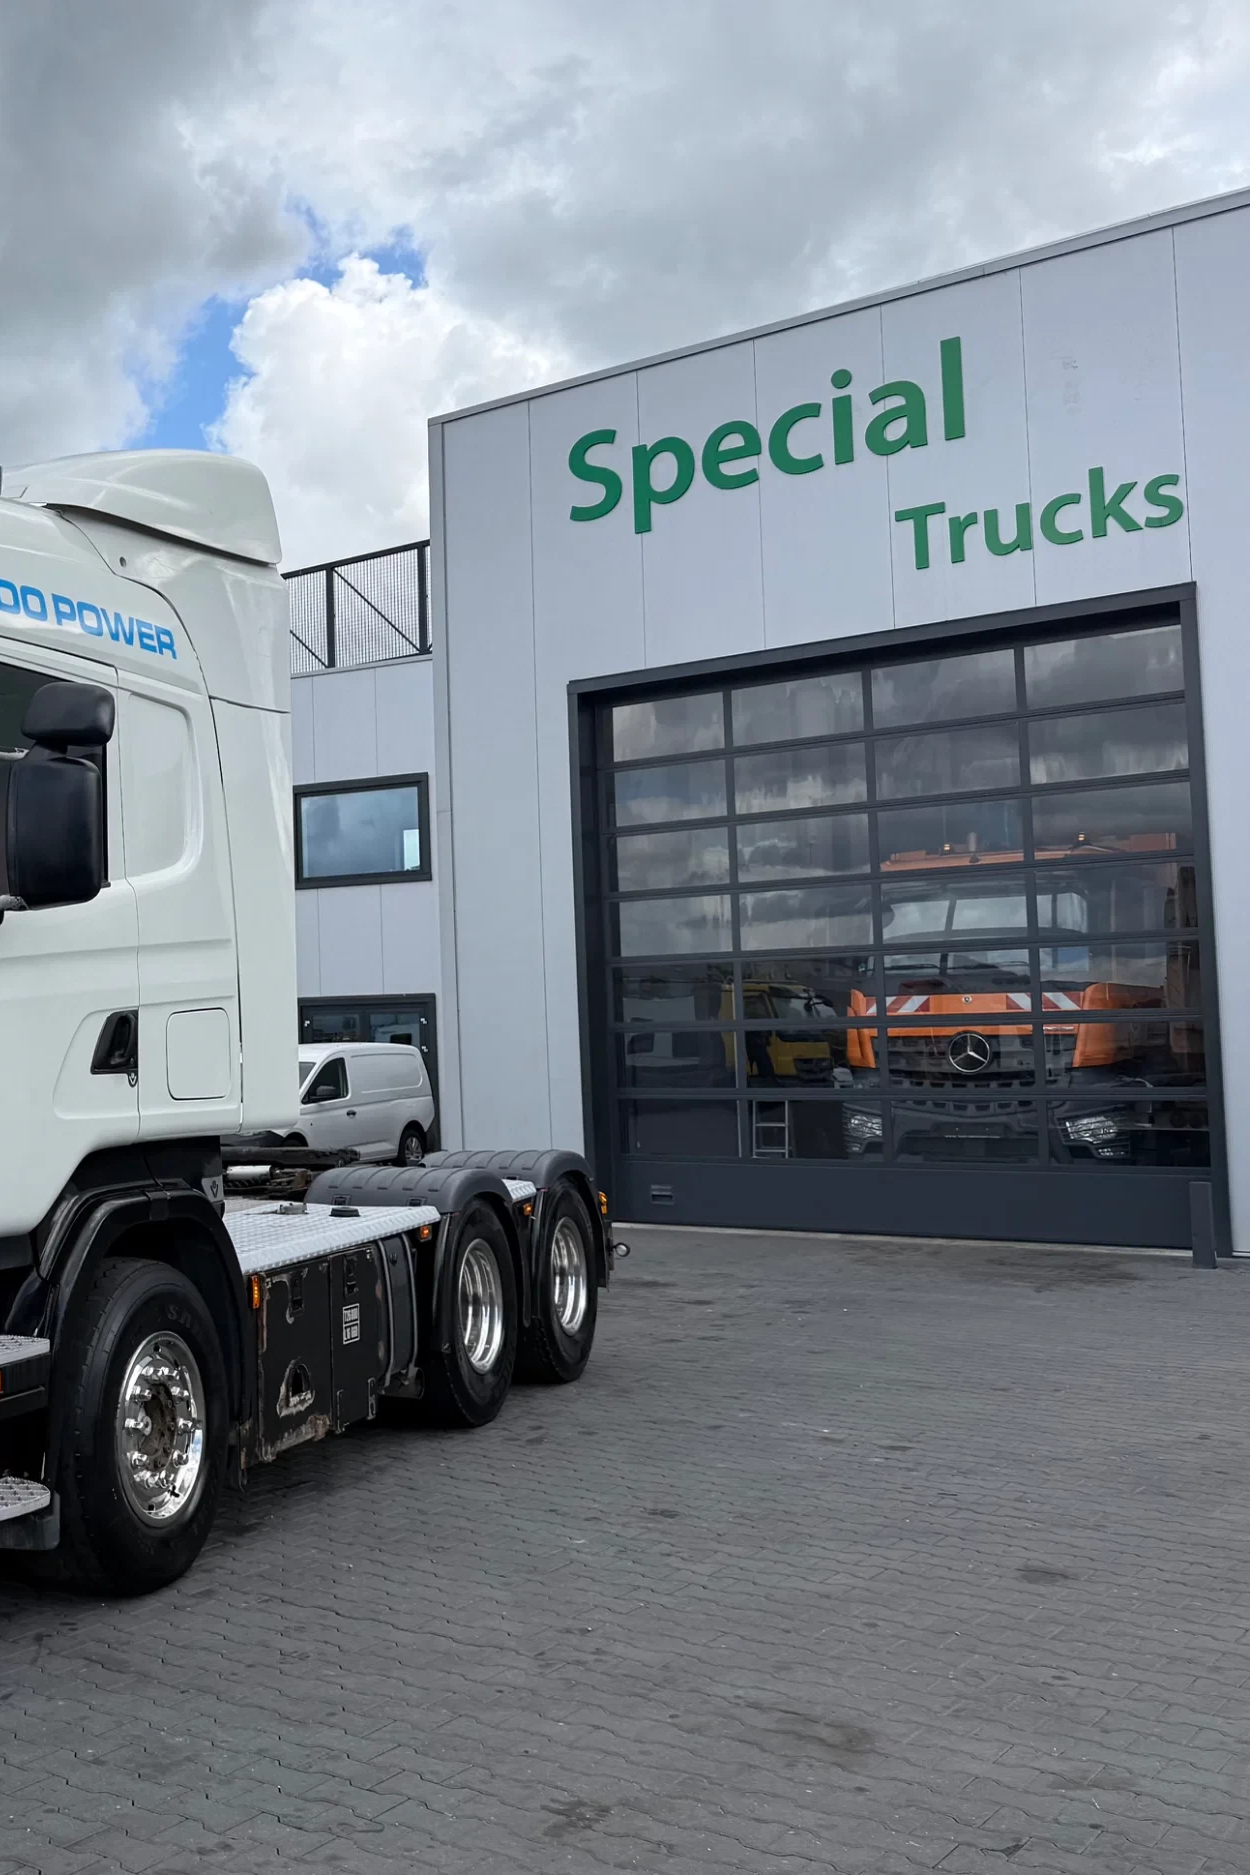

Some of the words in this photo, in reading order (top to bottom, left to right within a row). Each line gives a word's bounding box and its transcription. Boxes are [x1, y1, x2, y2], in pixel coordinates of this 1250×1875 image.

[568, 336, 966, 534] Special
[894, 466, 1184, 570] Trucks
[51, 593, 178, 660] POWER
